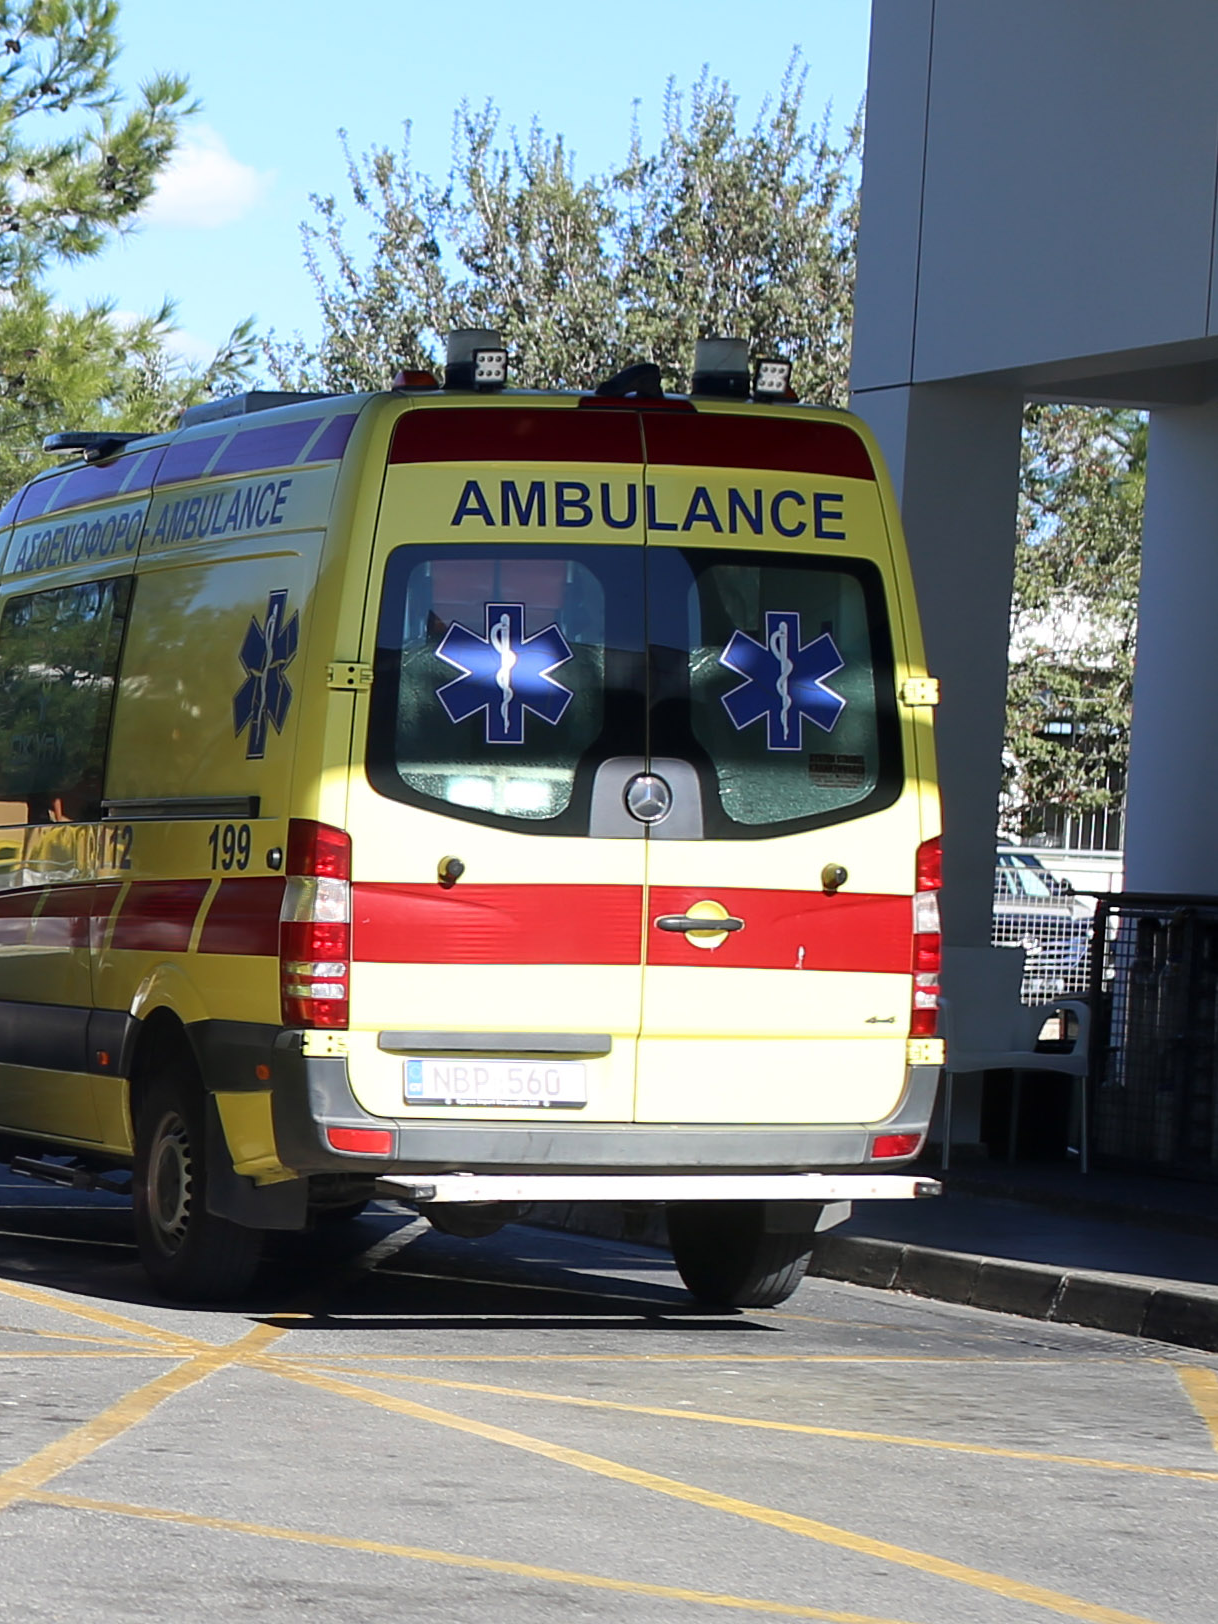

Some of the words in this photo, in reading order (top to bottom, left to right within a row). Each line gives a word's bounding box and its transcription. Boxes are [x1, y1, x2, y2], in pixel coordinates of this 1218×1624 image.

[150, 478, 293, 546] AMBULANCE
[450, 480, 847, 541] AMBULANCE
[208, 823, 252, 871] 199
[433, 1066, 489, 1094] NBP
[508, 1068, 560, 1096] 560
